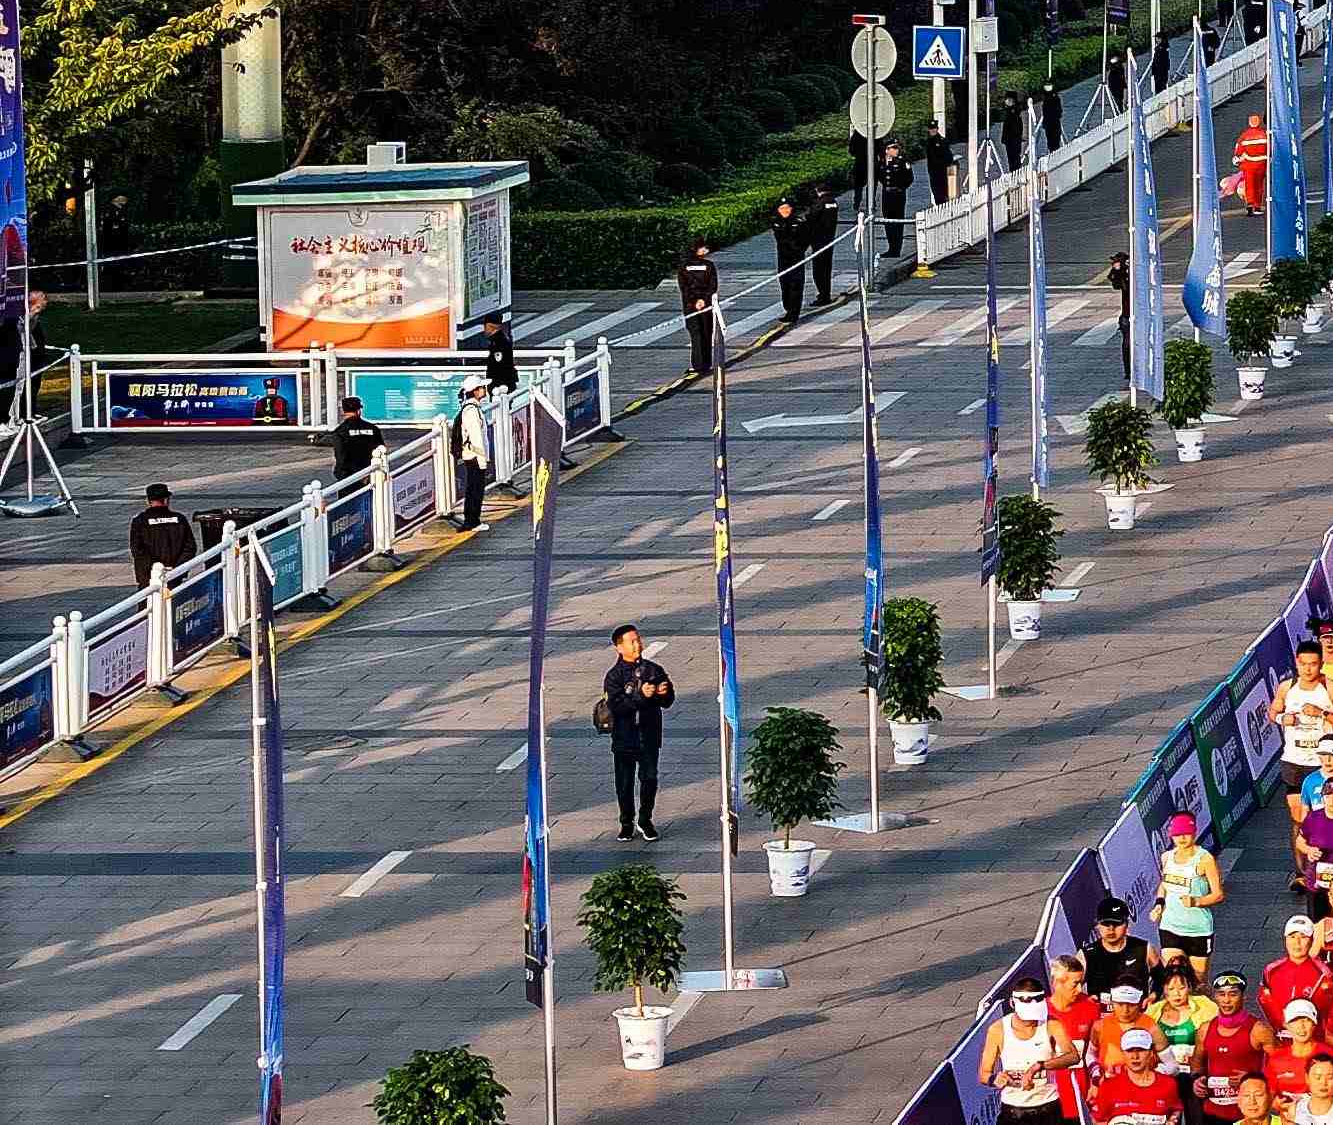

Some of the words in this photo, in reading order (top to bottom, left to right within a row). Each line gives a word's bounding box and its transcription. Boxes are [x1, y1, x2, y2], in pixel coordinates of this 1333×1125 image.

[290, 235, 429, 257] 社会主义核心价值观
